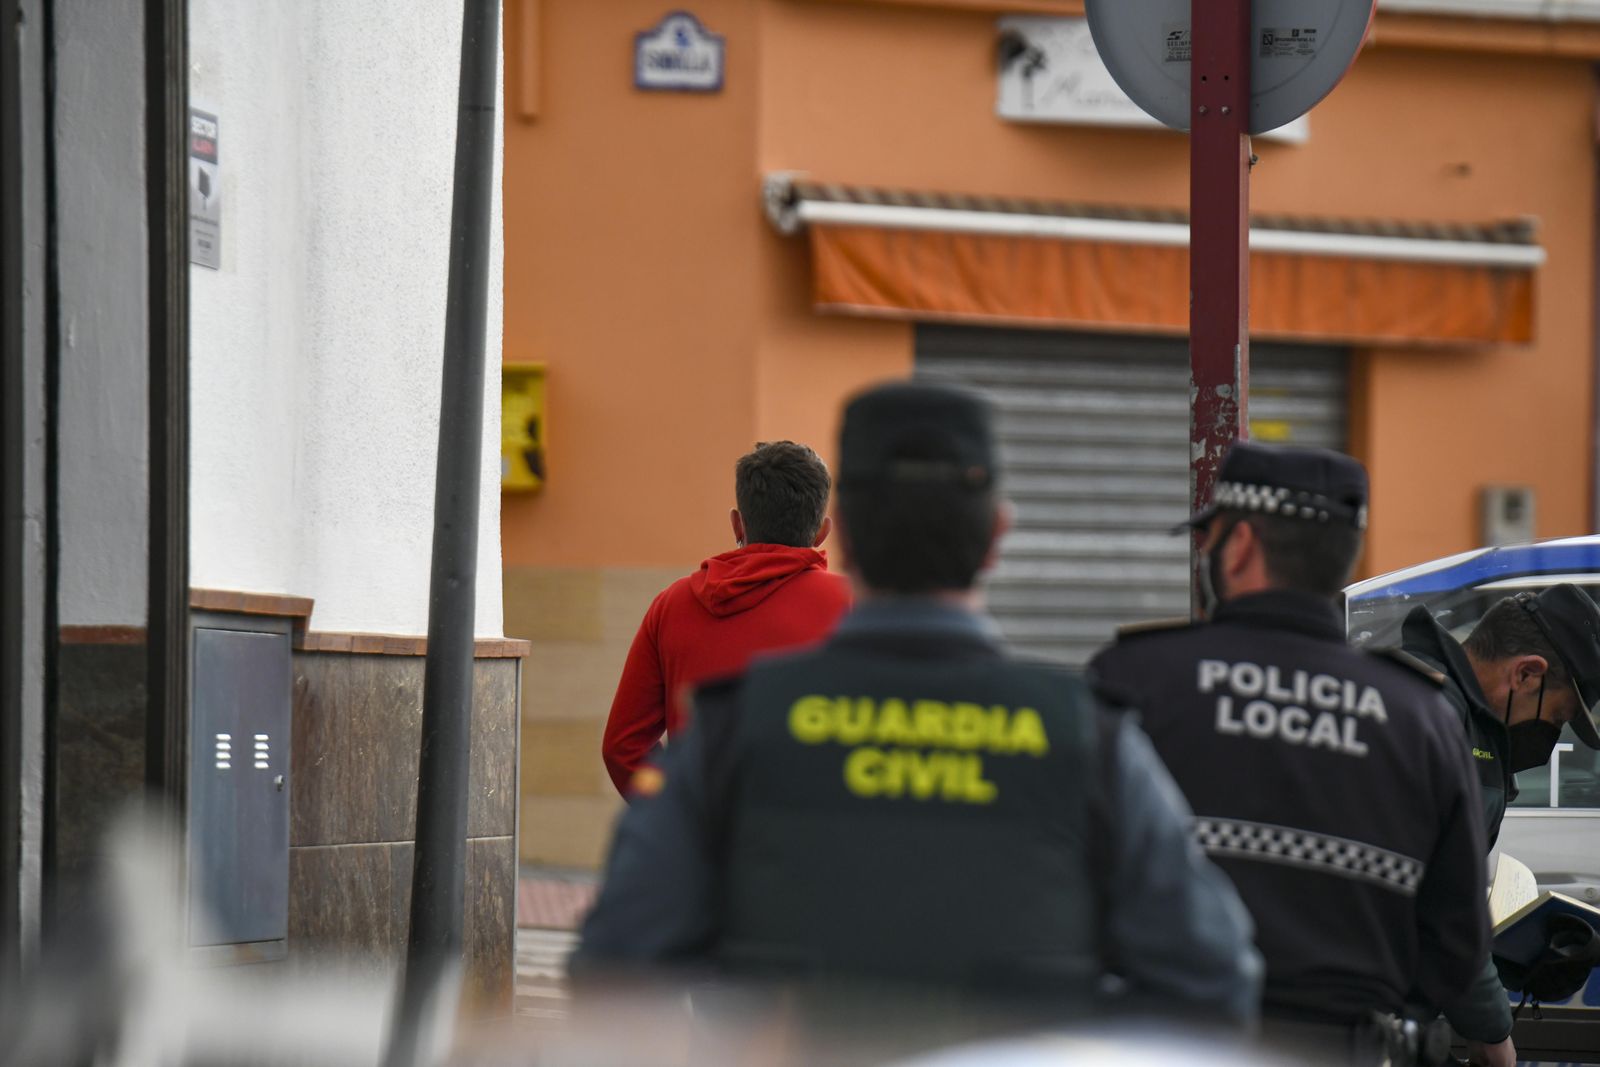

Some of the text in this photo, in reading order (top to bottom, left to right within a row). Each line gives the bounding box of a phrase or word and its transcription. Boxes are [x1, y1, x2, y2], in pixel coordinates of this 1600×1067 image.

[1199, 659, 1388, 723] POLICIA
[788, 695, 1049, 757] GUARDIA
[1216, 695, 1369, 757] LOCAL
[844, 746, 997, 804] CIVIL
